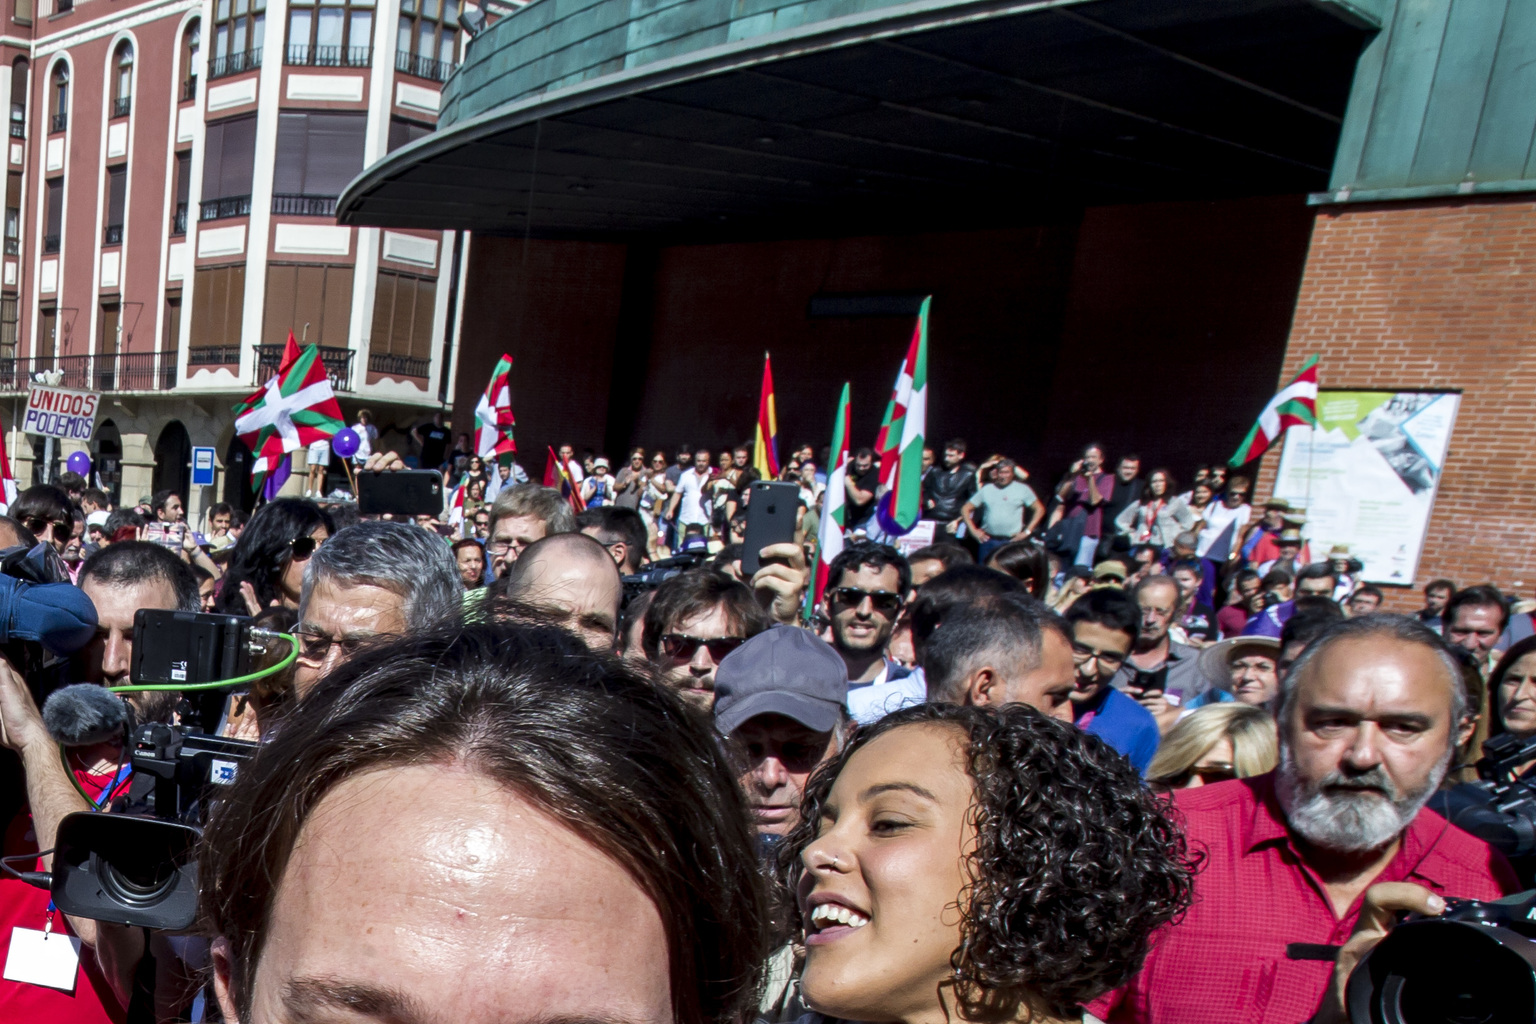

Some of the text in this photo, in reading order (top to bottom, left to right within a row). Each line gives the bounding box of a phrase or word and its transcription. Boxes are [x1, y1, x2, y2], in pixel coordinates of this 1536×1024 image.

[29, 388, 97, 417] UNIDOS
[24, 409, 94, 439] PODEMOS
[134, 750, 156, 758] Canon
